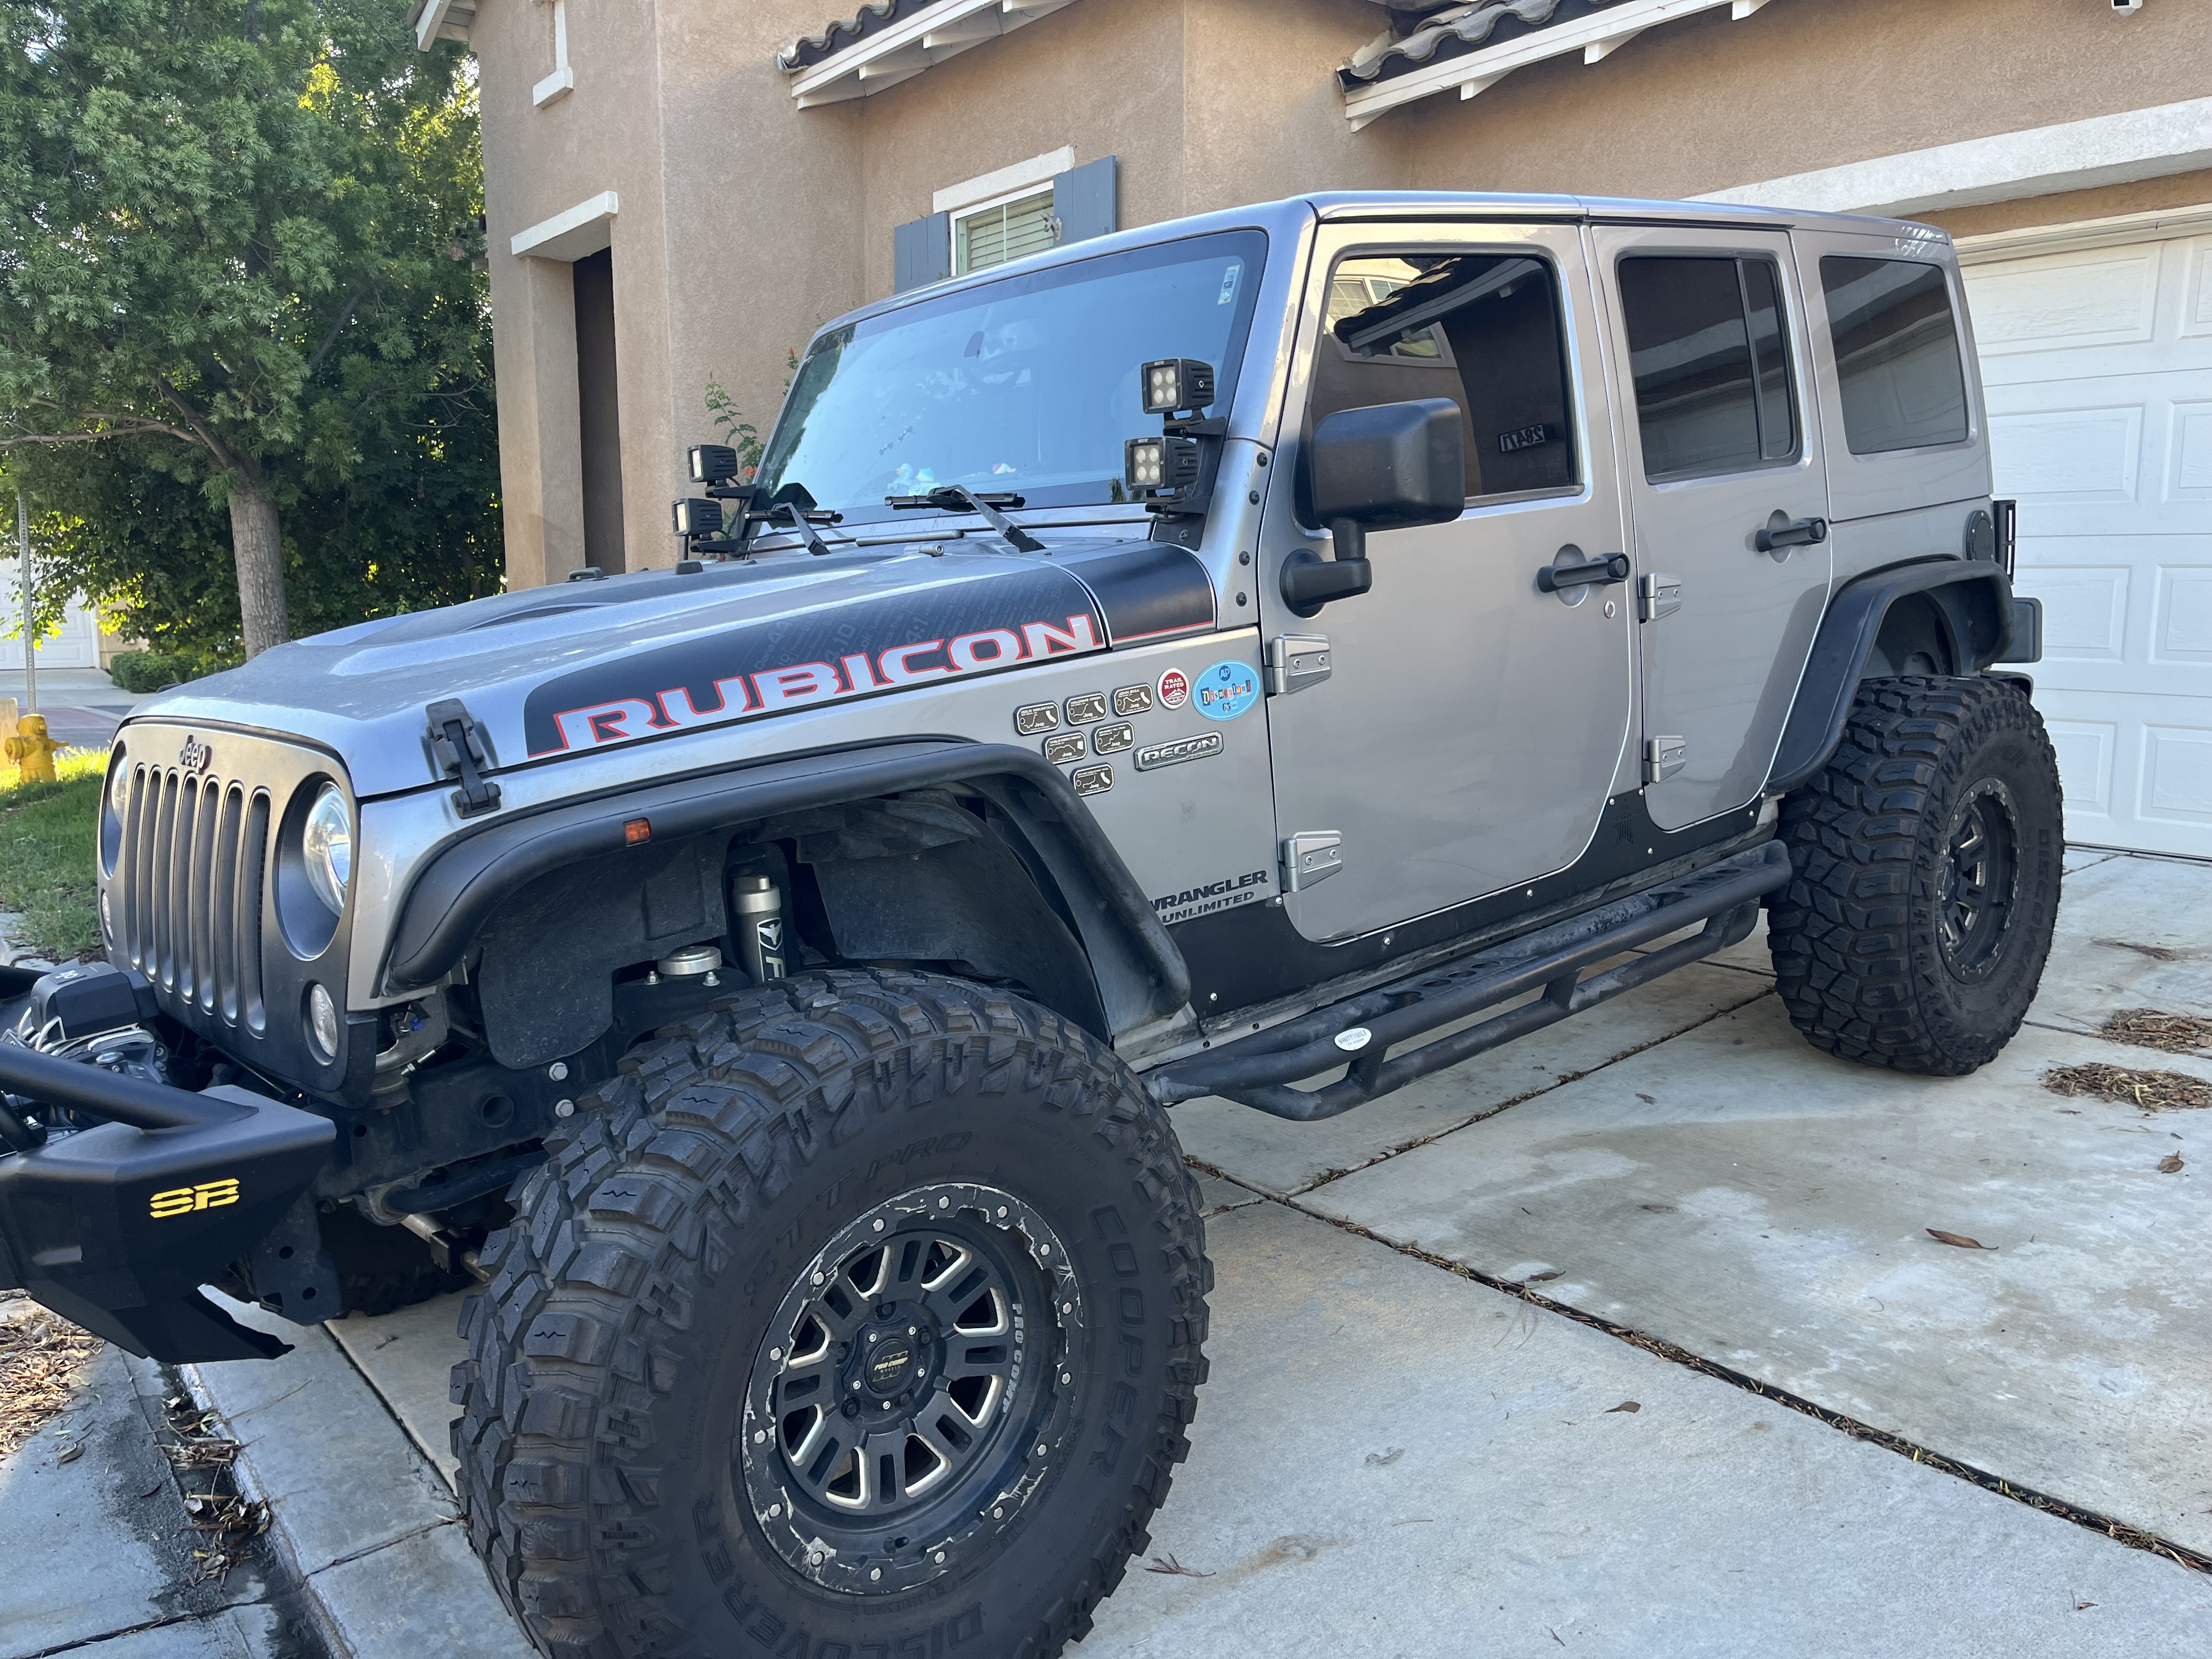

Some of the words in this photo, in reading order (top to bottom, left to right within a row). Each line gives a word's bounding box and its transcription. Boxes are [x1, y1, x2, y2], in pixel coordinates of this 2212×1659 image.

[553, 613, 1102, 749] RUBICON
[1164, 682, 1184, 690] RATED
[1220, 668, 1230, 679] AP
[1201, 679, 1251, 706] Disneyland
[179, 735, 211, 775] Jeep
[1144, 737, 1217, 761] RECON
[1161, 891, 1255, 924] UNLIMITED
[1338, 1030, 1367, 1045] SMITTYBILT
[868, 1131, 973, 1181] PRO
[1012, 1303, 1024, 1344] PRO
[1088, 1204, 1146, 1477] COOPER
[874, 1362, 888, 1371] PRO
[888, 1357, 908, 1367] COMP
[1002, 1349, 1023, 1414] COMP
